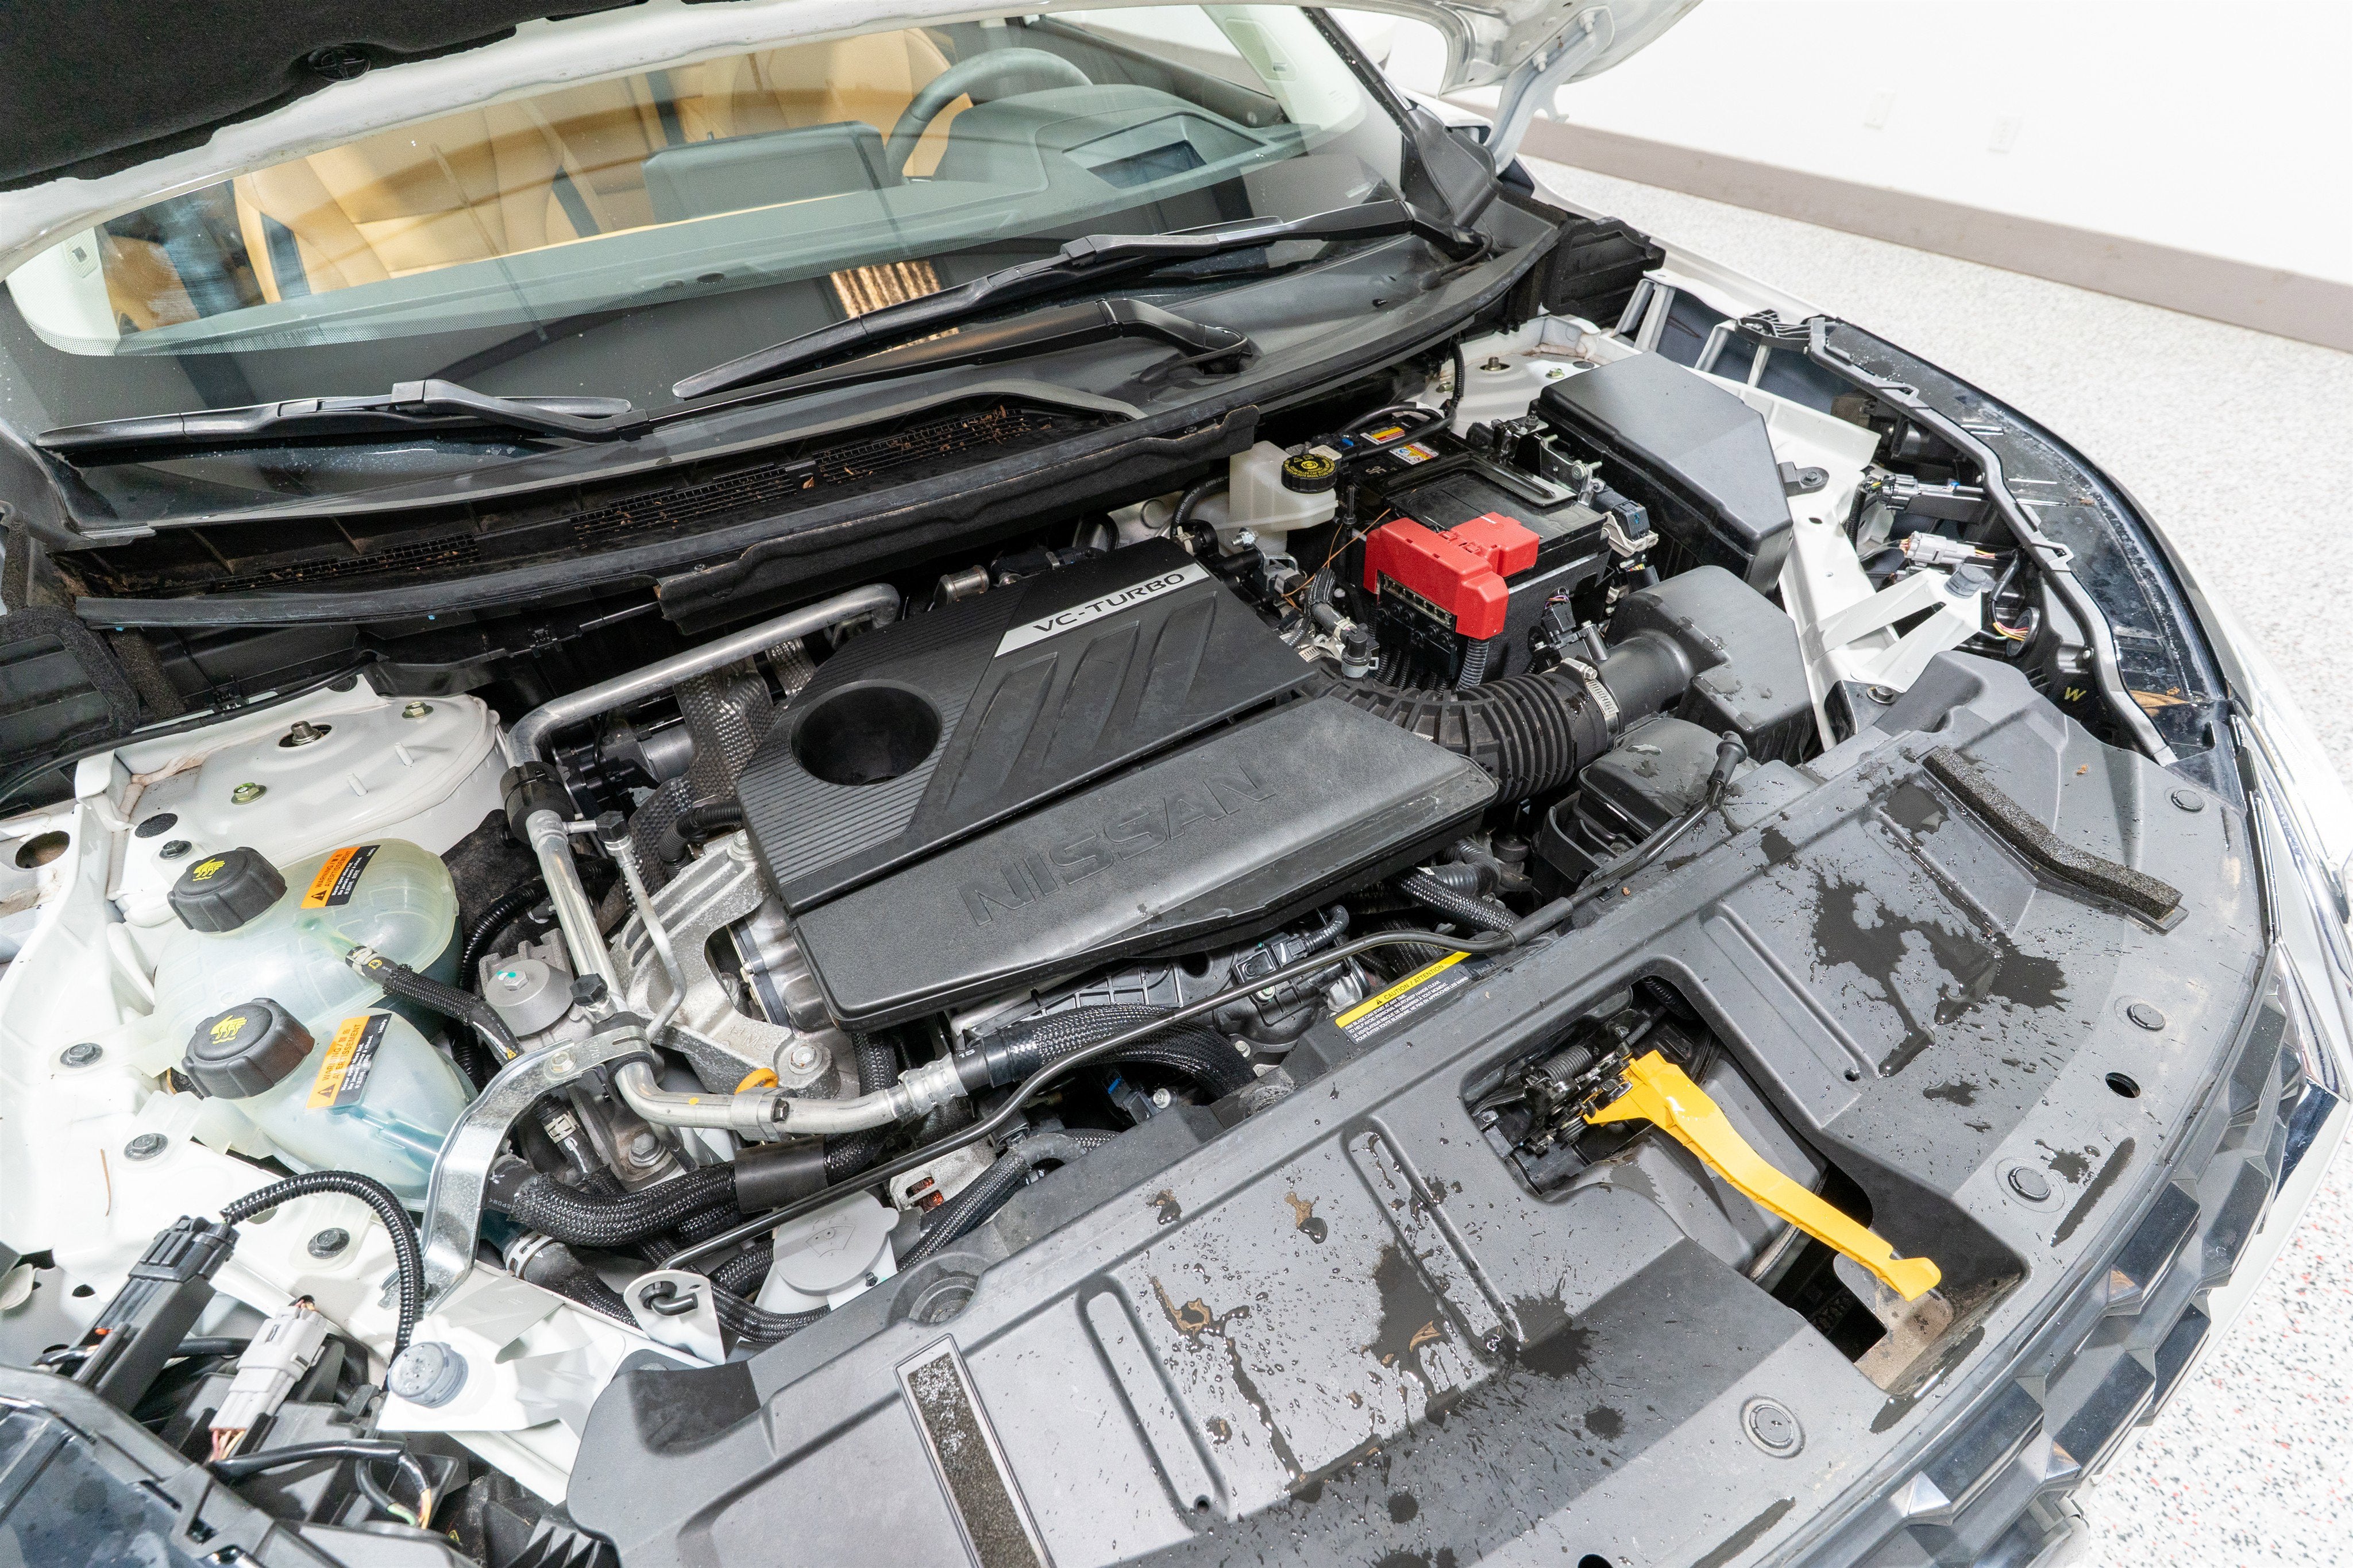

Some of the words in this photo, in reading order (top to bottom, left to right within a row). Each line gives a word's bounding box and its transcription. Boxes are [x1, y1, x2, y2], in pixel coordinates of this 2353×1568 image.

[1033, 574, 1185, 632] VC-TURBO
[959, 764, 1276, 926] NISSAN
[314, 864, 334, 887] WARNING
[324, 851, 352, 886] AVERTISSEMENT
[1383, 983, 1410, 1001] CAUTION
[1413, 963, 1444, 983] ATTENTION
[1352, 1016, 1365, 1026] BLADE
[1372, 1005, 1385, 1014] START
[1353, 1022, 1365, 1030] HELP
[1363, 1016, 1376, 1025] AVOID
[1374, 1005, 1395, 1019] PERSONAL
[1414, 986, 1429, 996] HANDS
[1426, 979, 1441, 989] CLEAR.
[1355, 1033, 1368, 1042] POUR
[1365, 1026, 1380, 1036] ÉVITER
[1378, 1019, 1392, 1029] TOUTE
[1427, 986, 1451, 1001] APPROCHER
[1356, 1019, 1382, 1036] VENTILATEUR
[1379, 1011, 1396, 1022] RISQUE
[1421, 990, 1432, 998] TOUT
[1430, 982, 1448, 993] MOMENT.
[322, 1047, 342, 1080] WARNING
[958, 1049, 975, 1059] 15
[340, 1077, 350, 1091] Never
